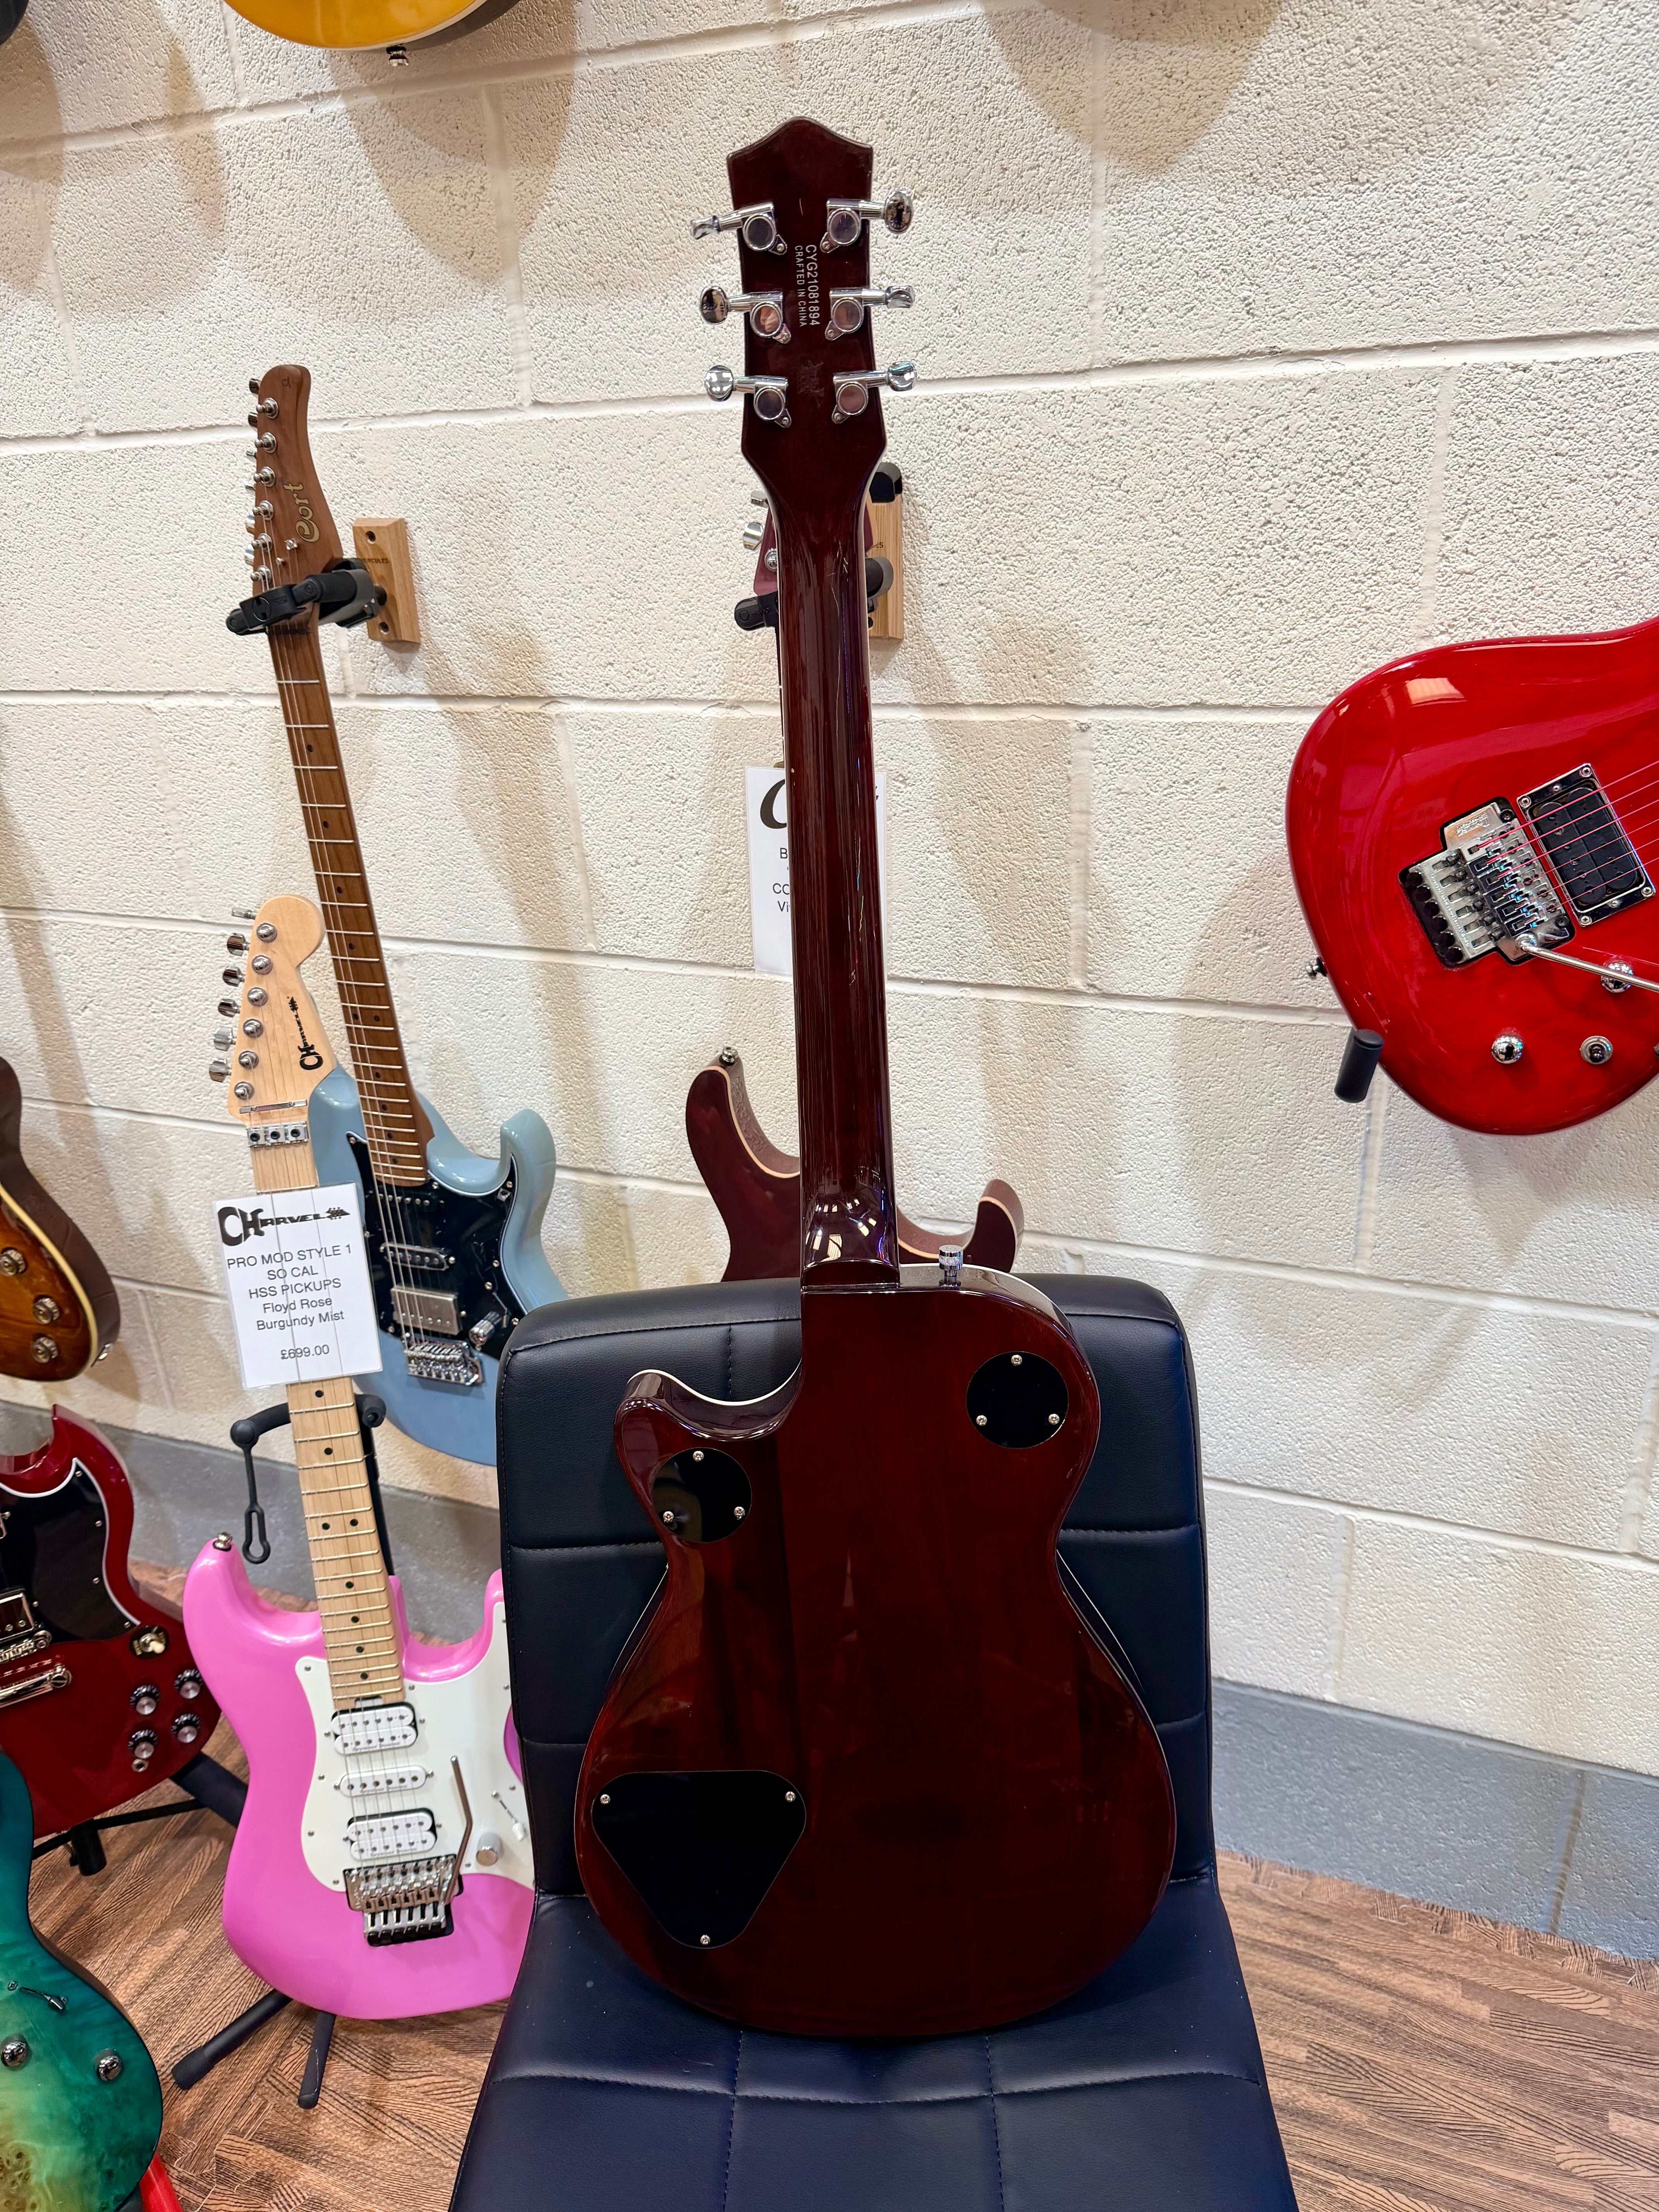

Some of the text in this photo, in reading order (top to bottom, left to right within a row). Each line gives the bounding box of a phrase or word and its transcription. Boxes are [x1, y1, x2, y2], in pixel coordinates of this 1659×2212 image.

[795, 245, 807, 327] CRAFTED IN CHINA
[805, 244, 820, 326] CYG21081894
[283, 483, 320, 543] Cort
[227, 1244, 351, 1269] PRO MOD STYLE 1
[268, 1265, 318, 1280] SO CAL
[249, 1278, 342, 1298] HSS PICKUPS
[263, 1298, 332, 1314] Floyd Rose
[257, 1310, 345, 1330] Burgundy Mist
[280, 1344, 330, 1360] £699.00
